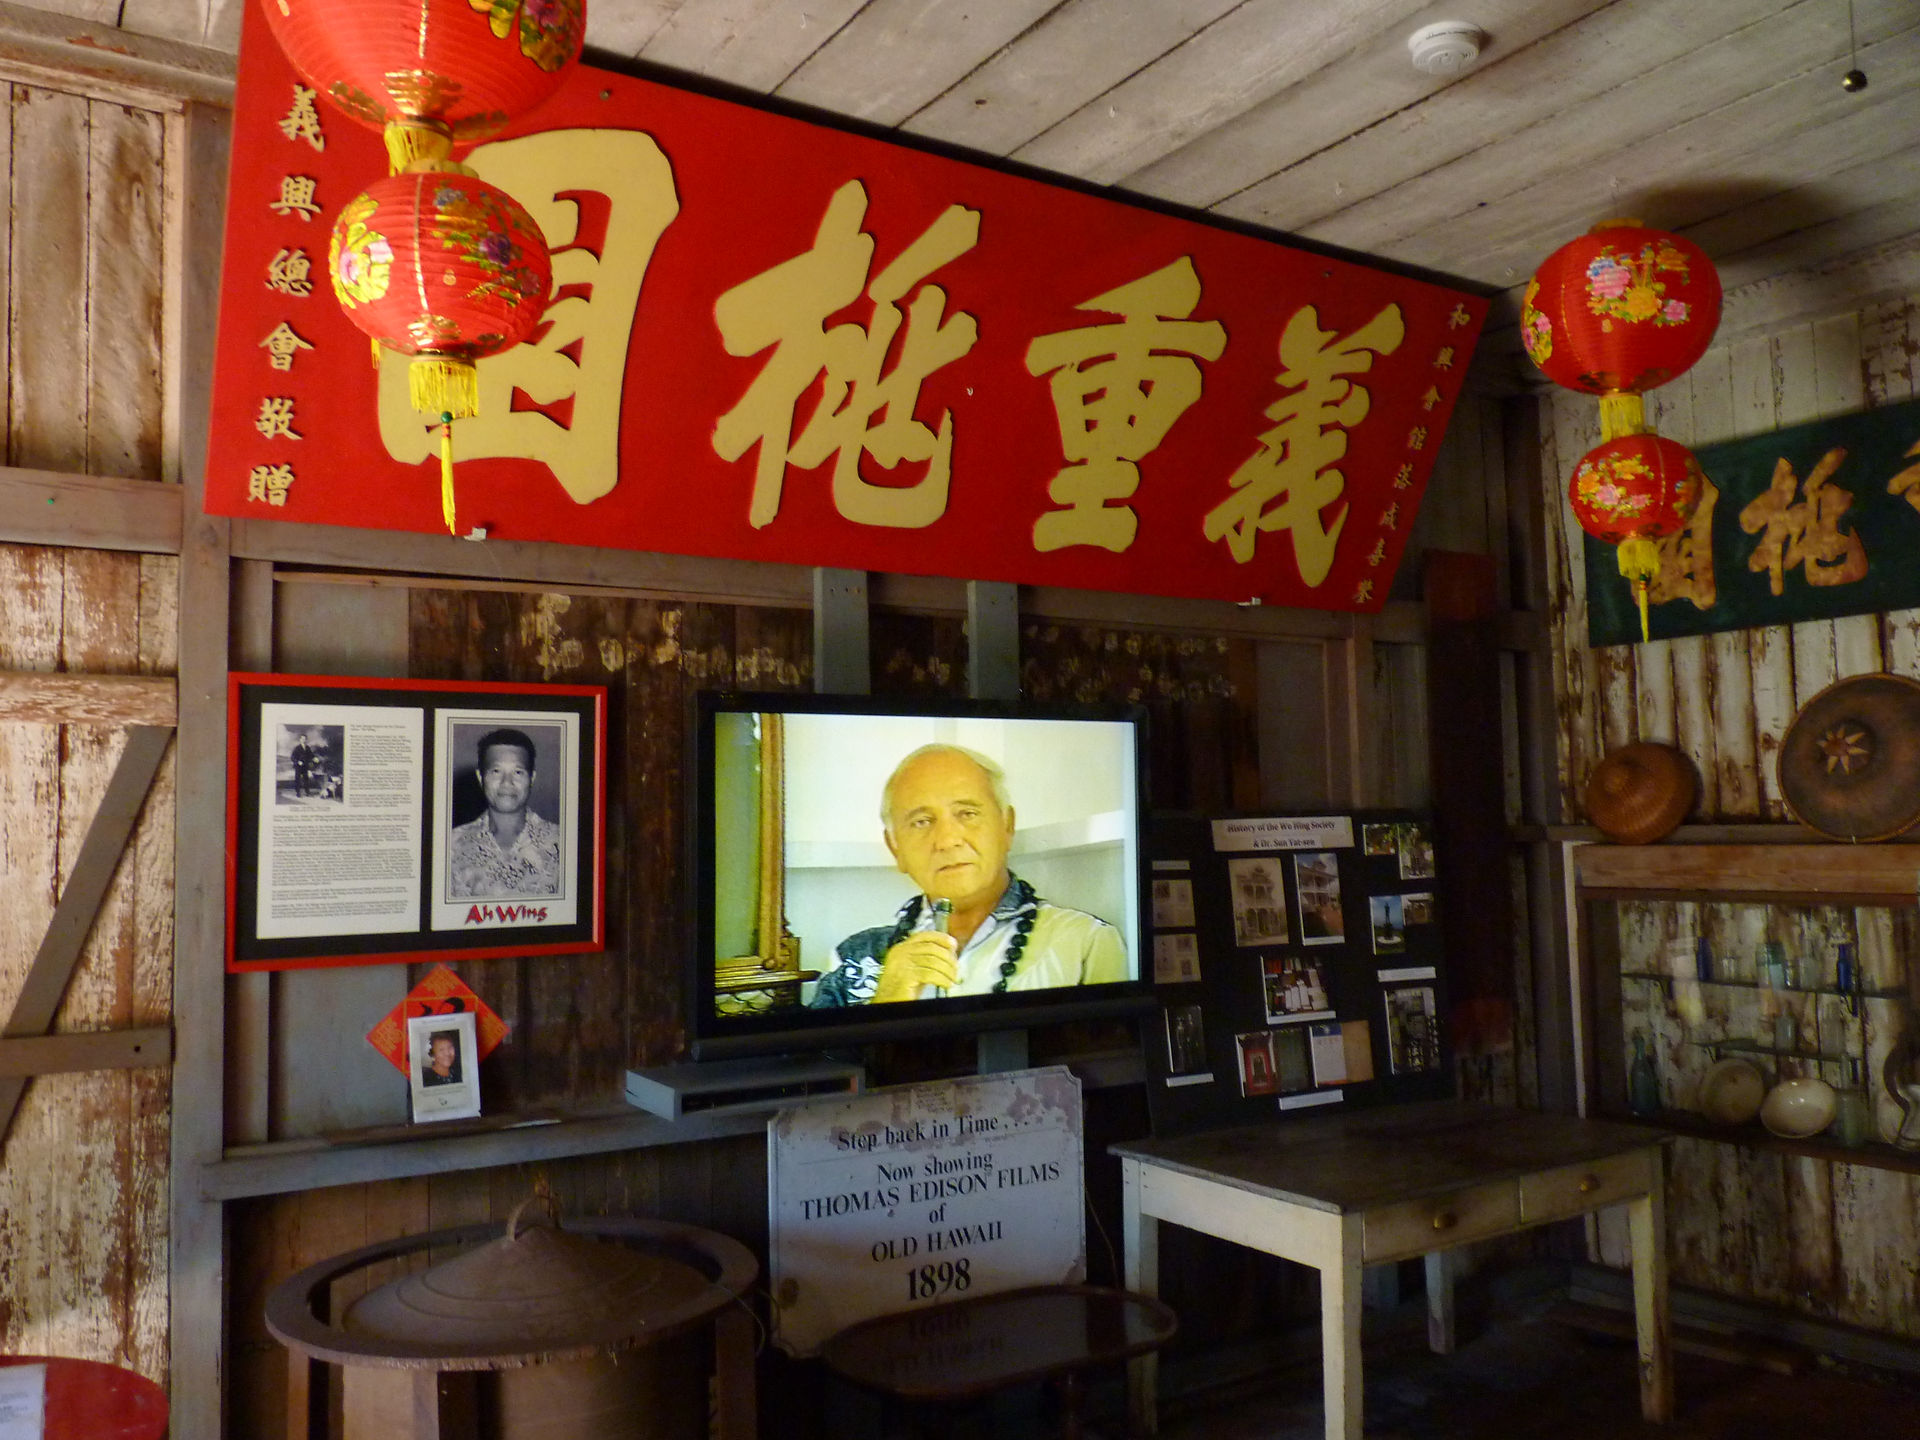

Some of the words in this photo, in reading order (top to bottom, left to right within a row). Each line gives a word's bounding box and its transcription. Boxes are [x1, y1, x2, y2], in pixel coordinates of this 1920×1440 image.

[1227, 824, 1255, 833] History
[1257, 823, 1266, 831] of
[1266, 822, 1279, 831] the
[1311, 820, 1336, 830] Society
[1273, 839, 1287, 847] Sun
[464, 904, 494, 925] Ah
[836, 1128, 879, 1152] Step
[885, 1121, 925, 1146] back
[932, 1118, 949, 1138] in
[958, 1113, 999, 1135] Time
[877, 1163, 914, 1185] Now
[923, 1151, 994, 1178] showing
[799, 1187, 900, 1221] THOMAS
[909, 1174, 989, 1204] EDISON
[997, 1160, 1061, 1190] FILMS
[928, 1203, 947, 1225] of
[871, 1236, 918, 1264] OLD
[927, 1221, 1004, 1252] HAWAII
[907, 1257, 972, 1301] 1898
